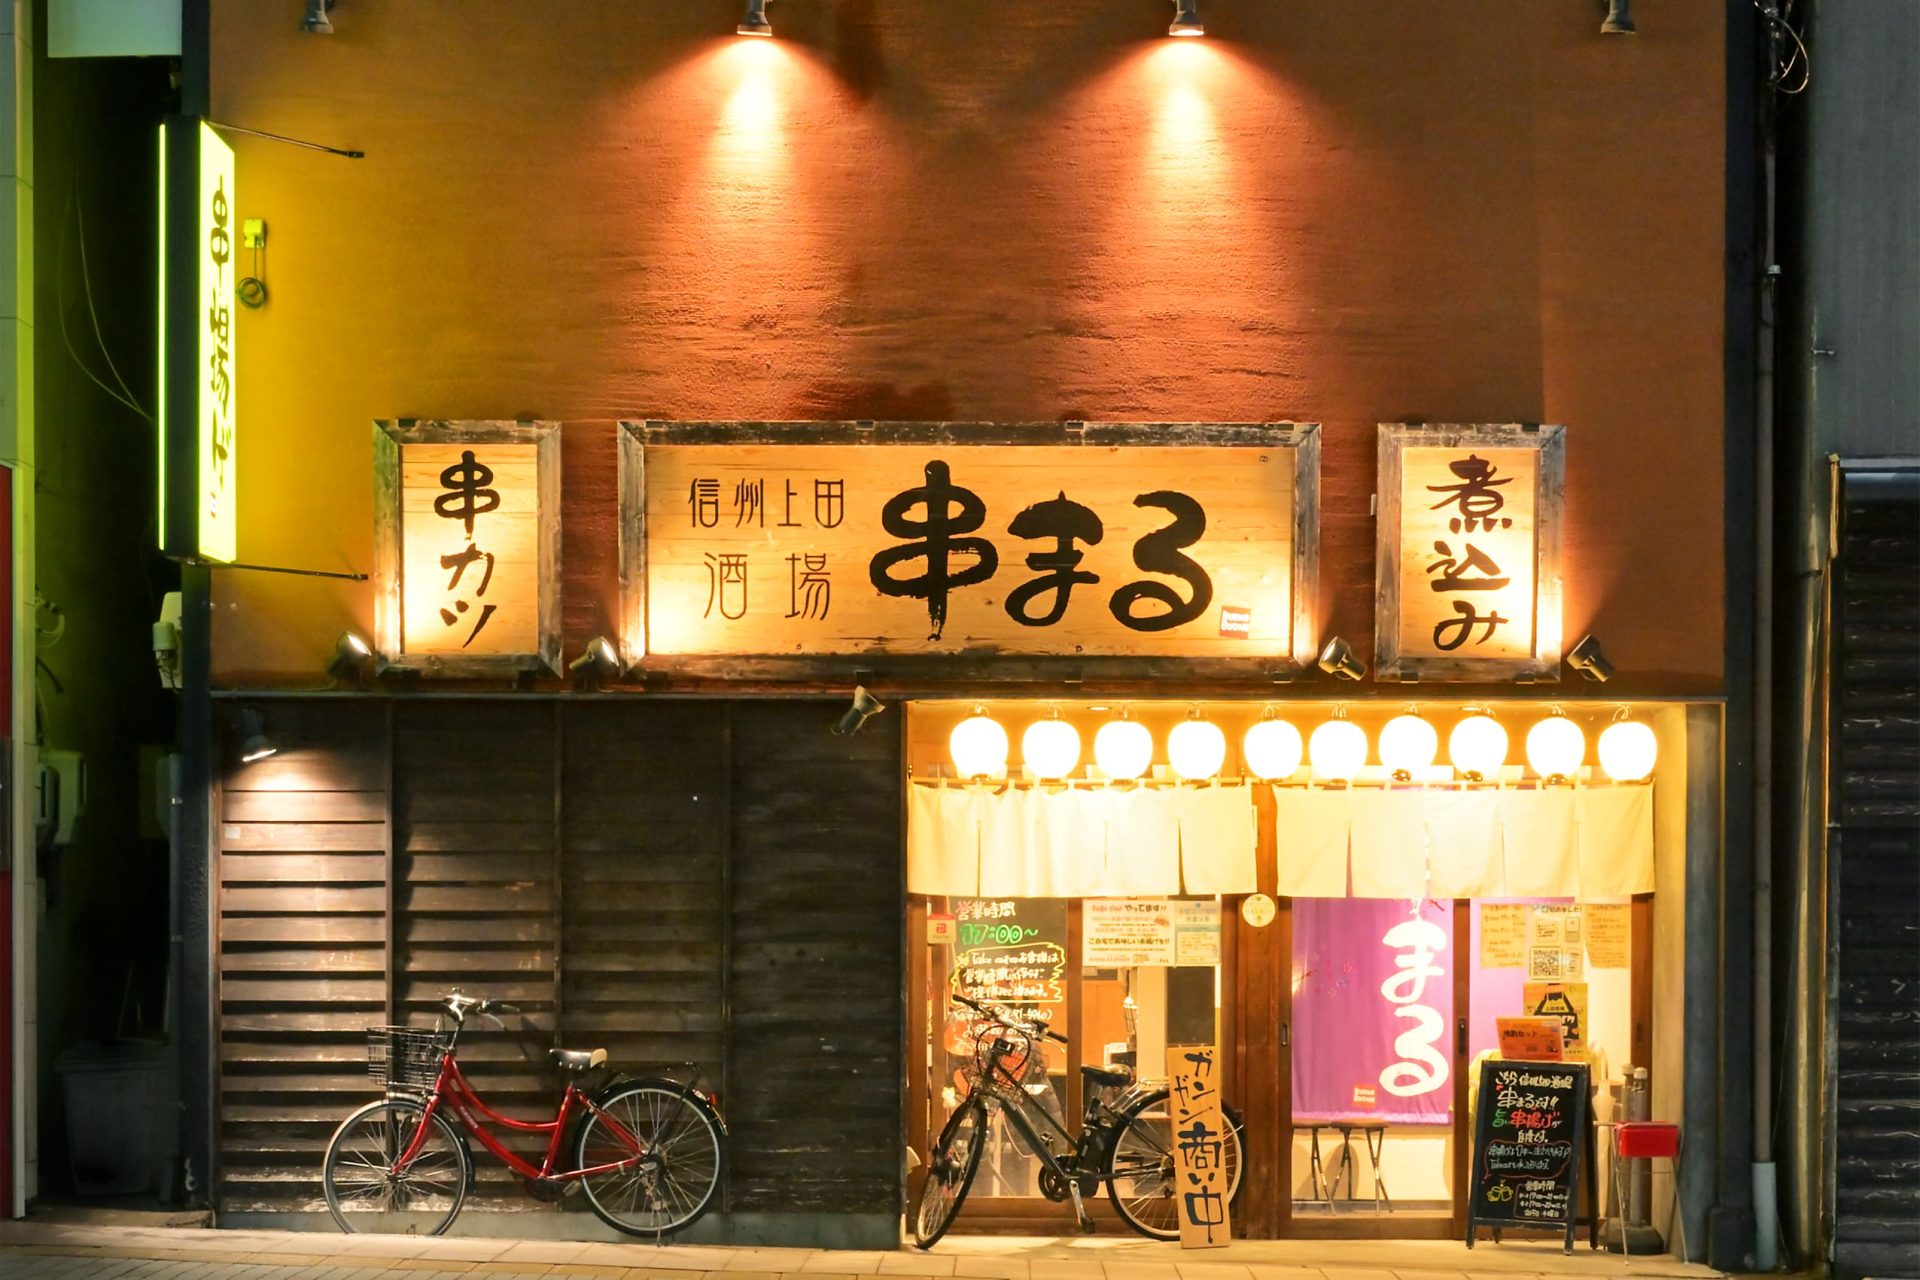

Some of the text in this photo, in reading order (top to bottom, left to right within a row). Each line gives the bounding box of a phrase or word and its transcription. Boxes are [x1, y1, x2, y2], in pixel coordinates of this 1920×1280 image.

[433, 449, 501, 648] 串カツ
[688, 477, 844, 529] 信州上田
[703, 552, 831, 621] 酒場
[868, 458, 1214, 642] 串まる
[1426, 454, 1514, 651] 煮込み
[956, 900, 1016, 921] 営業時間
[1378, 897, 1450, 1097] まる
